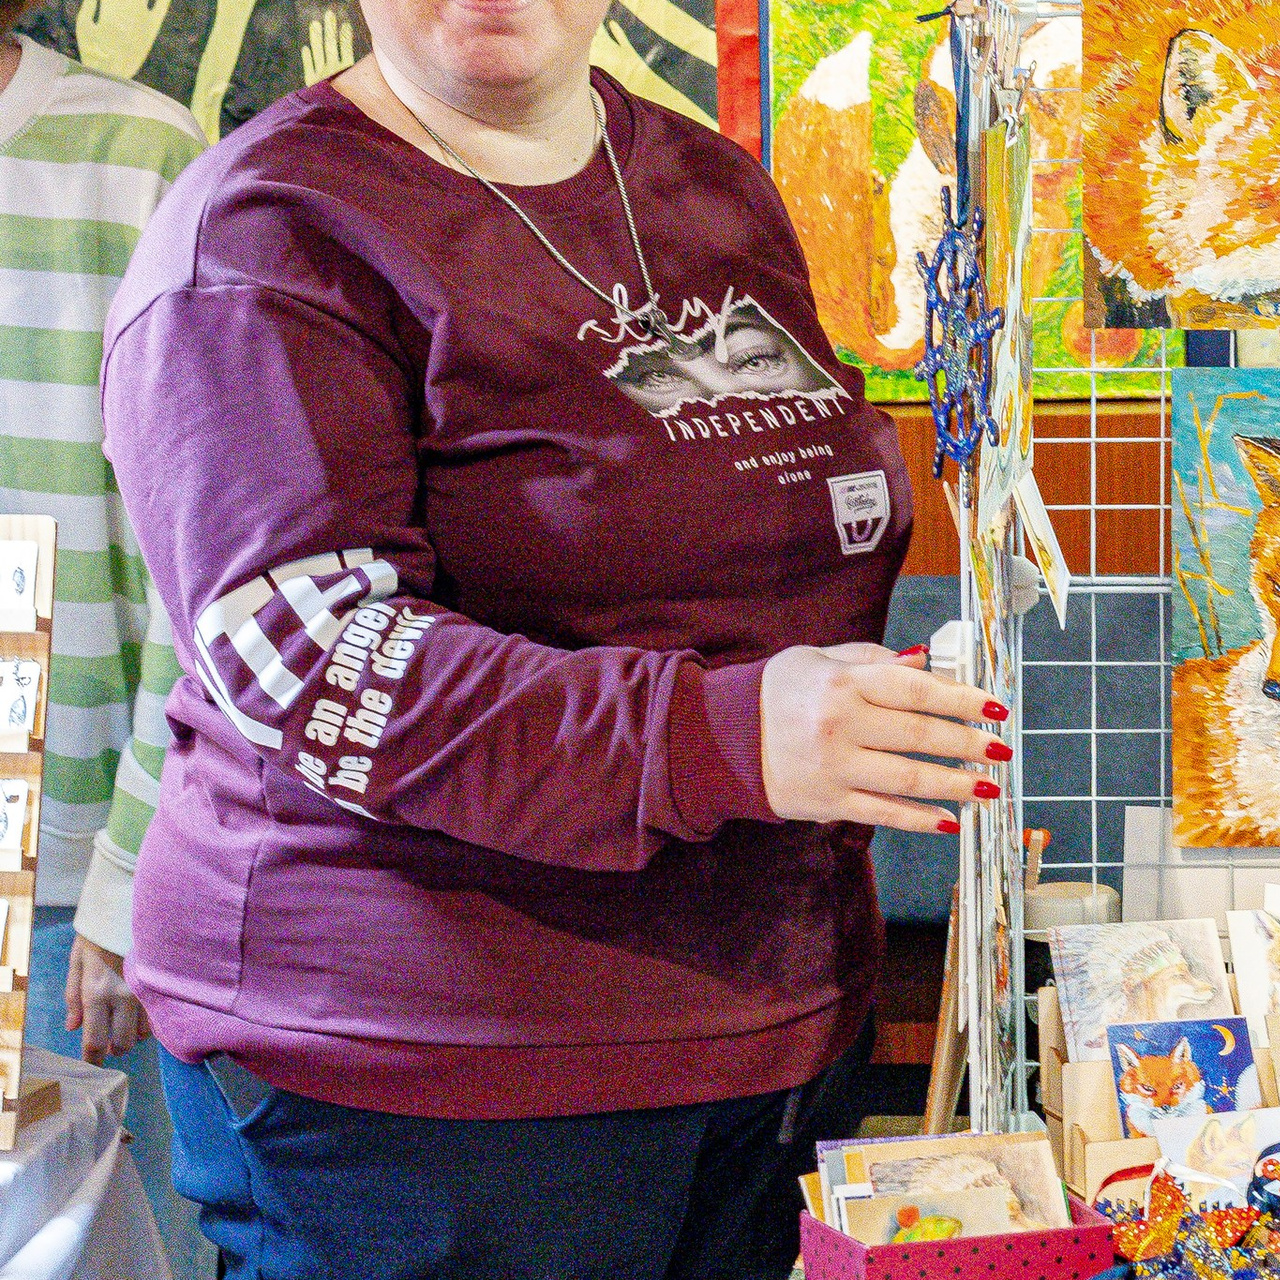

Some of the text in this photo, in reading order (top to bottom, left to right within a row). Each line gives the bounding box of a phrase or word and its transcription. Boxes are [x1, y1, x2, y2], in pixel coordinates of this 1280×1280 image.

[662, 397, 846, 442] INDEPENDENT
[734, 444, 834, 472] and enjoy being
[777, 469, 812, 485] alone
[304, 698, 348, 747] an
[343, 687, 393, 749] the
[328, 755, 373, 795] be
